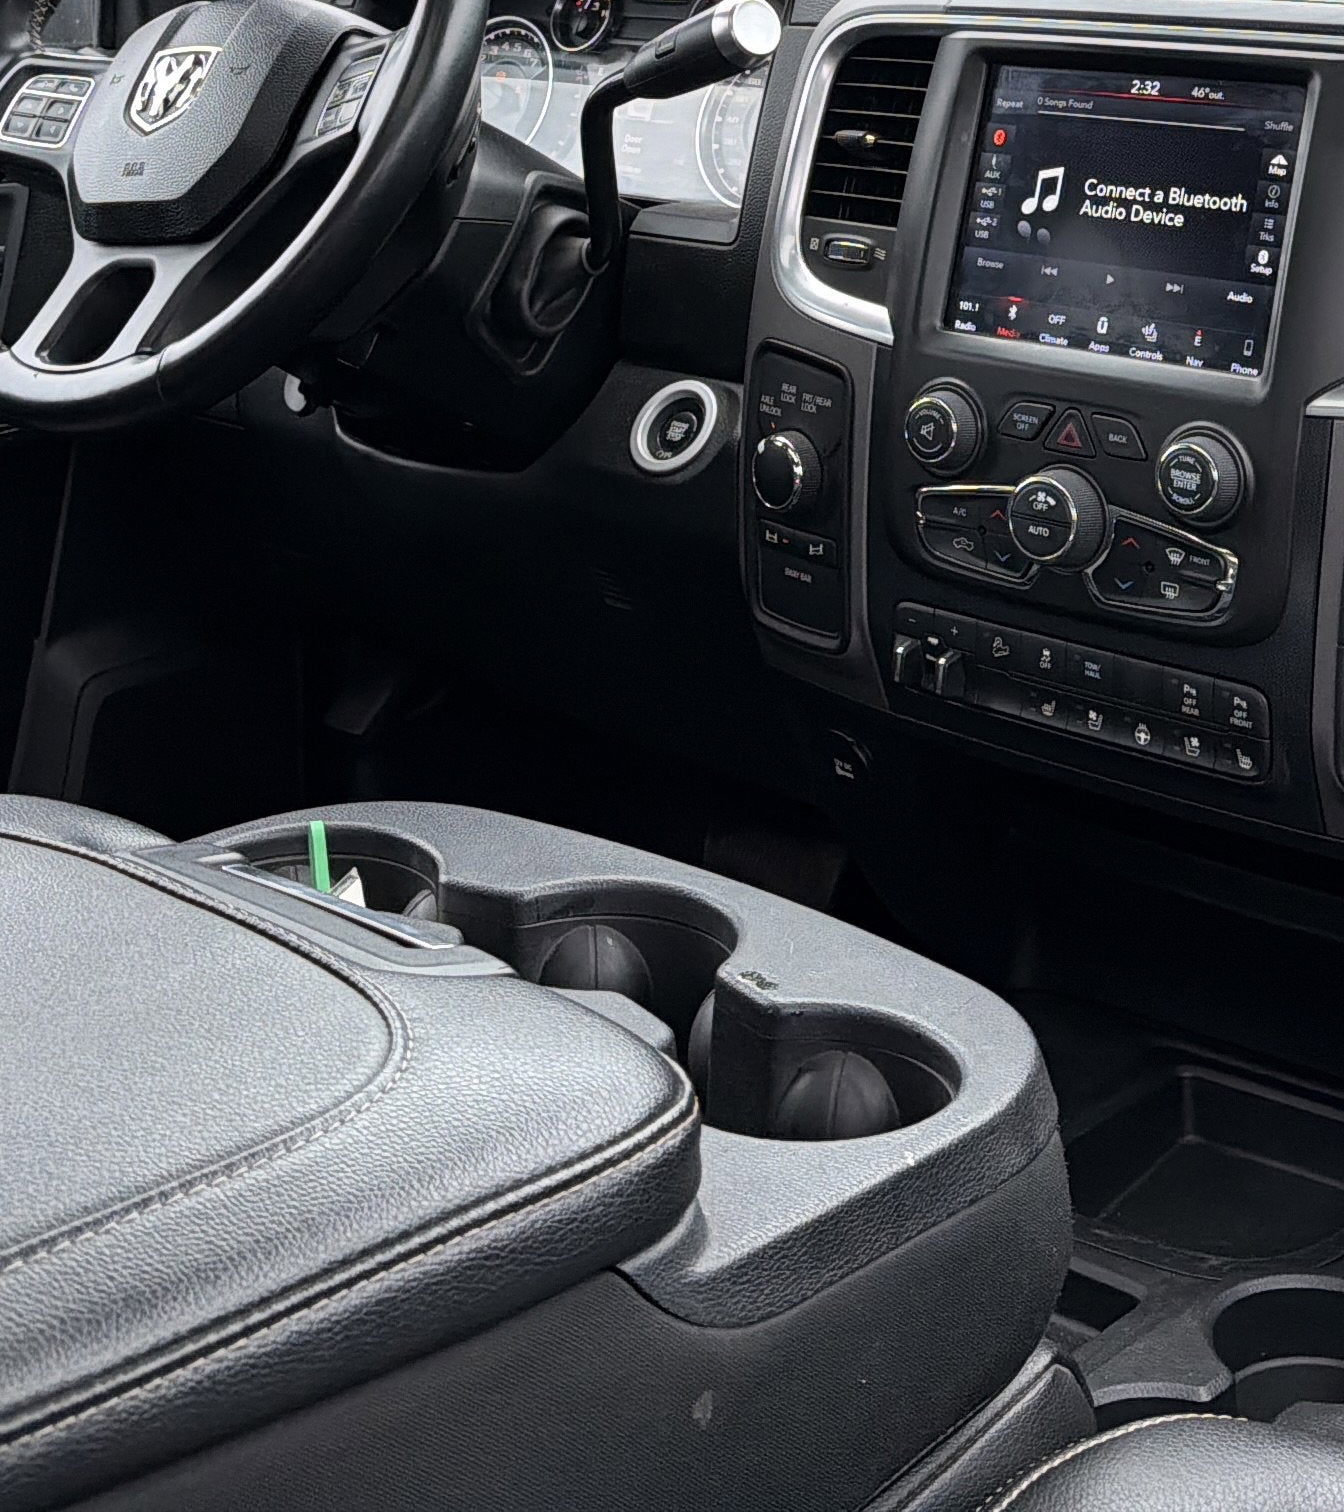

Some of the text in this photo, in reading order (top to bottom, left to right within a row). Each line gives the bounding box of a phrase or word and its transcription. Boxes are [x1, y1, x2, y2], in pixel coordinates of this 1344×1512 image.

[1130, 79, 1161, 96] 2:32
[996, 98, 1024, 109] Repeat
[1044, 97, 1067, 108] Songs
[1068, 98, 1094, 110] Found
[1263, 120, 1294, 132] Shuffle
[984, 170, 1001, 179] AUX
[1268, 165, 1287, 177] Map
[1084, 178, 1247, 212] Connect a Bluetooth
[980, 200, 995, 209] USB
[1079, 199, 1185, 227] Audio Device
[974, 230, 989, 239] USB
[977, 257, 1004, 269] Browse
[1226, 291, 1254, 304] Audio
[954, 319, 977, 332] Radio
[1048, 314, 1066, 325] OFF
[1038, 332, 1069, 346] Climate
[1088, 341, 1110, 353] Apps
[1129, 347, 1164, 361] Controls
[1185, 356, 1204, 368] Nav
[1230, 362, 1259, 376] Phone
[1013, 413, 1038, 425] SCREEN
[1016, 422, 1029, 431] OFF
[1108, 433, 1128, 444] BACK
[1170, 468, 1202, 481] BROWSE
[1173, 480, 1197, 492] ENTER
[953, 506, 967, 517] A/C
[1032, 501, 1048, 511] OFF
[1028, 525, 1050, 537] AUTO
[1189, 555, 1210, 566] FRONT
[1039, 661, 1052, 670] OFF
[1183, 697, 1197, 706] OFF
[1233, 709, 1248, 719] OFF
